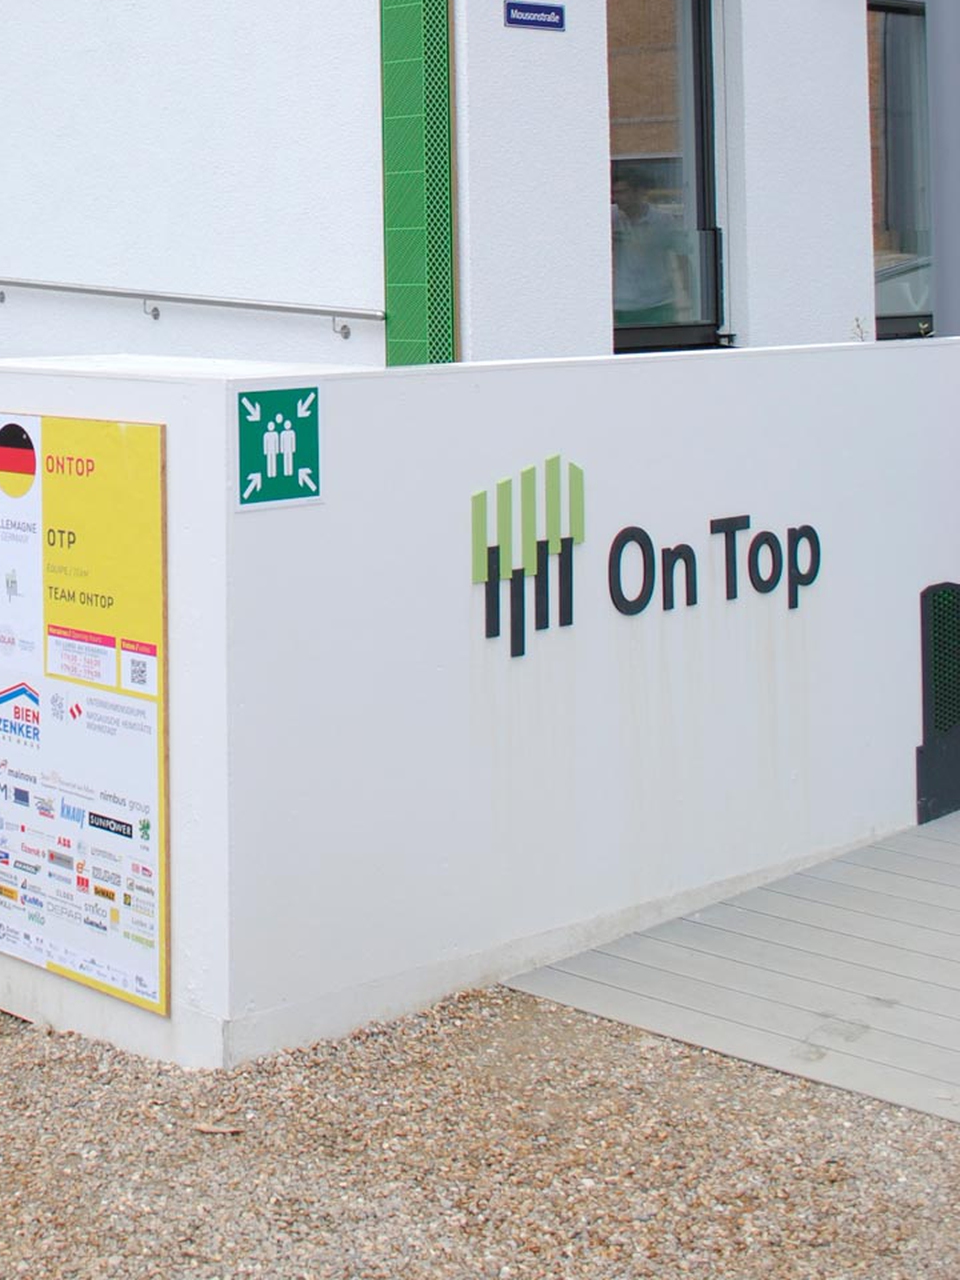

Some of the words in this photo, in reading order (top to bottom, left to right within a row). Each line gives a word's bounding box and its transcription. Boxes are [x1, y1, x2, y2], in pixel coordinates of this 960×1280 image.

[46, 455, 95, 477] ONTOP
[47, 528, 76, 549] OTP
[608, 526, 697, 616] On
[710, 515, 820, 609] Top
[49, 586, 76, 603] TEAM
[79, 592, 114, 609] ONTOP
[13, 706, 40, 723] BIEN
[100, 790, 126, 807] nimbus
[129, 800, 150, 815] group
[89, 814, 131, 836] SUNPOWER
